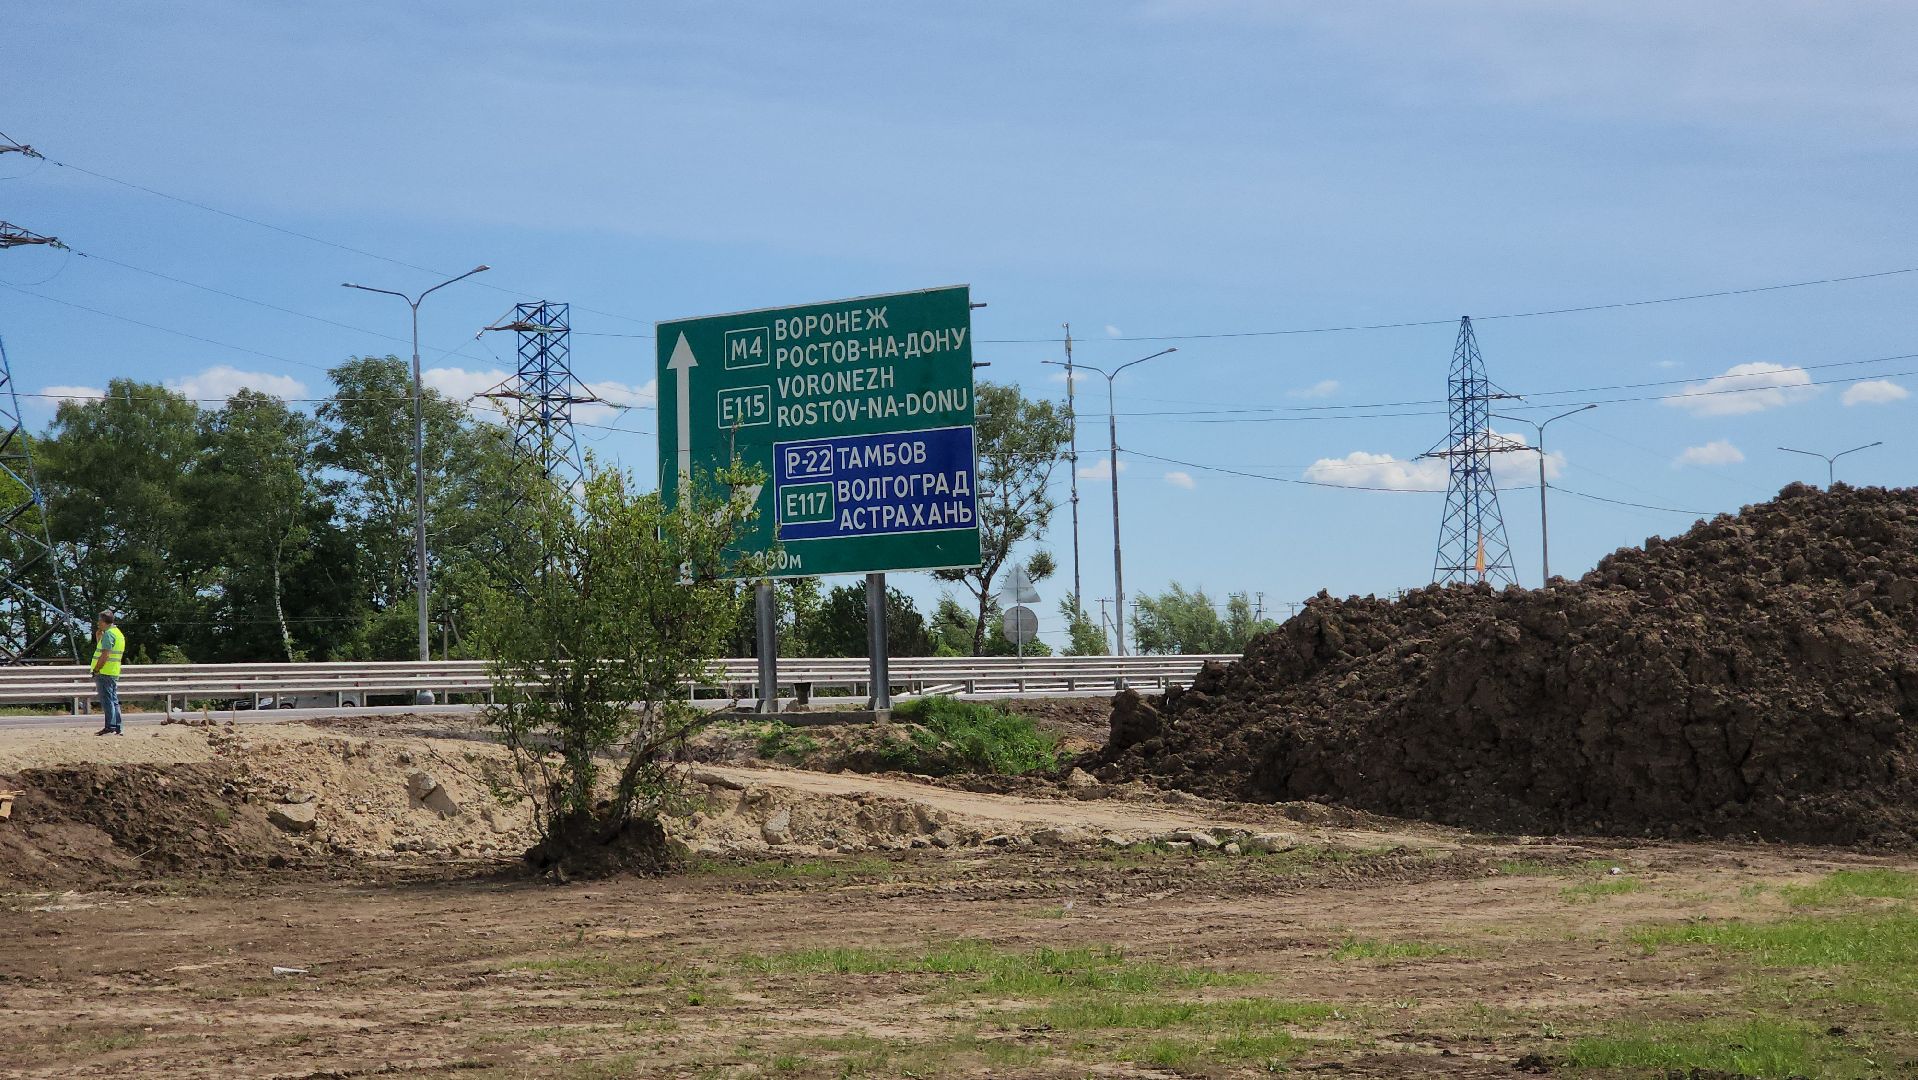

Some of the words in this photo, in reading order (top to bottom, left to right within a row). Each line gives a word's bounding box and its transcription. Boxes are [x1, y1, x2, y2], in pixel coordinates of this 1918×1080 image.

[775, 306, 889, 340] ВОРОНЕЖ
[776, 327, 966, 369] РОСТОВ-НА-ДОНУ
[777, 366, 894, 399] VORONEZH
[777, 388, 967, 427] ROSTOV-NA-DONU
[837, 442, 926, 470] ТАМБОВ
[838, 471, 969, 502] ВОЛГОГРАД
[839, 501, 972, 530] АСТРАХАНЬ
